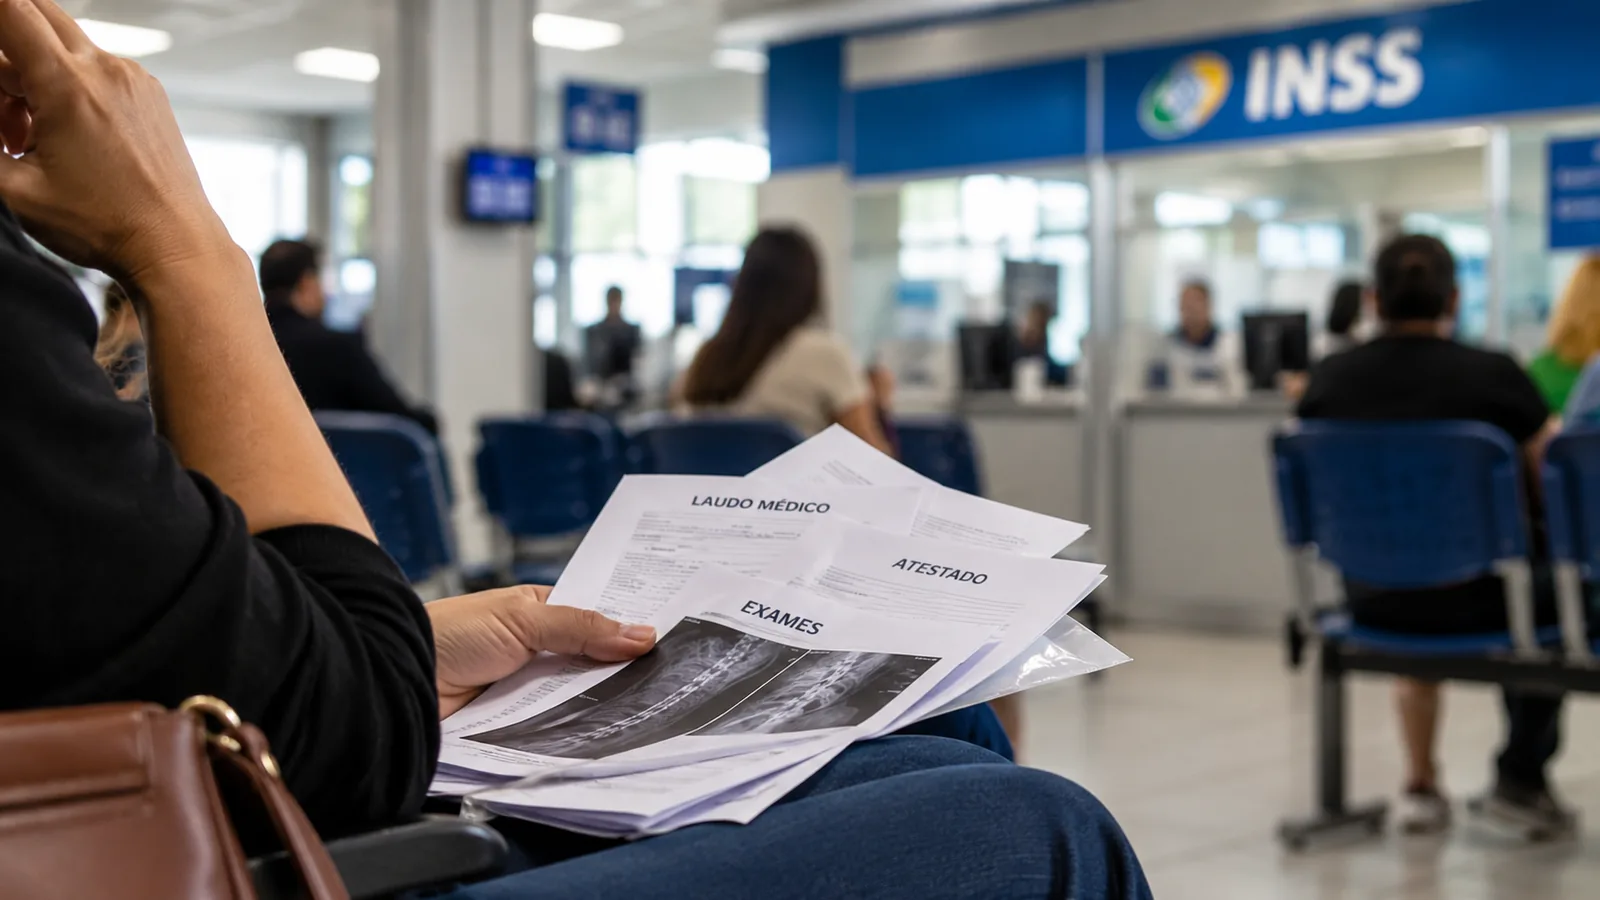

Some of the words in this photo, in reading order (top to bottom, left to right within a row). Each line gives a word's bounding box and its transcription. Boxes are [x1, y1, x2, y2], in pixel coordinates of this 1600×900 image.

[1245, 28, 1424, 121] INSS
[691, 495, 754, 510] LAUDO
[757, 498, 831, 514] MÉDICO
[892, 557, 988, 585] ATESTADO
[740, 600, 824, 635] EXAMES
